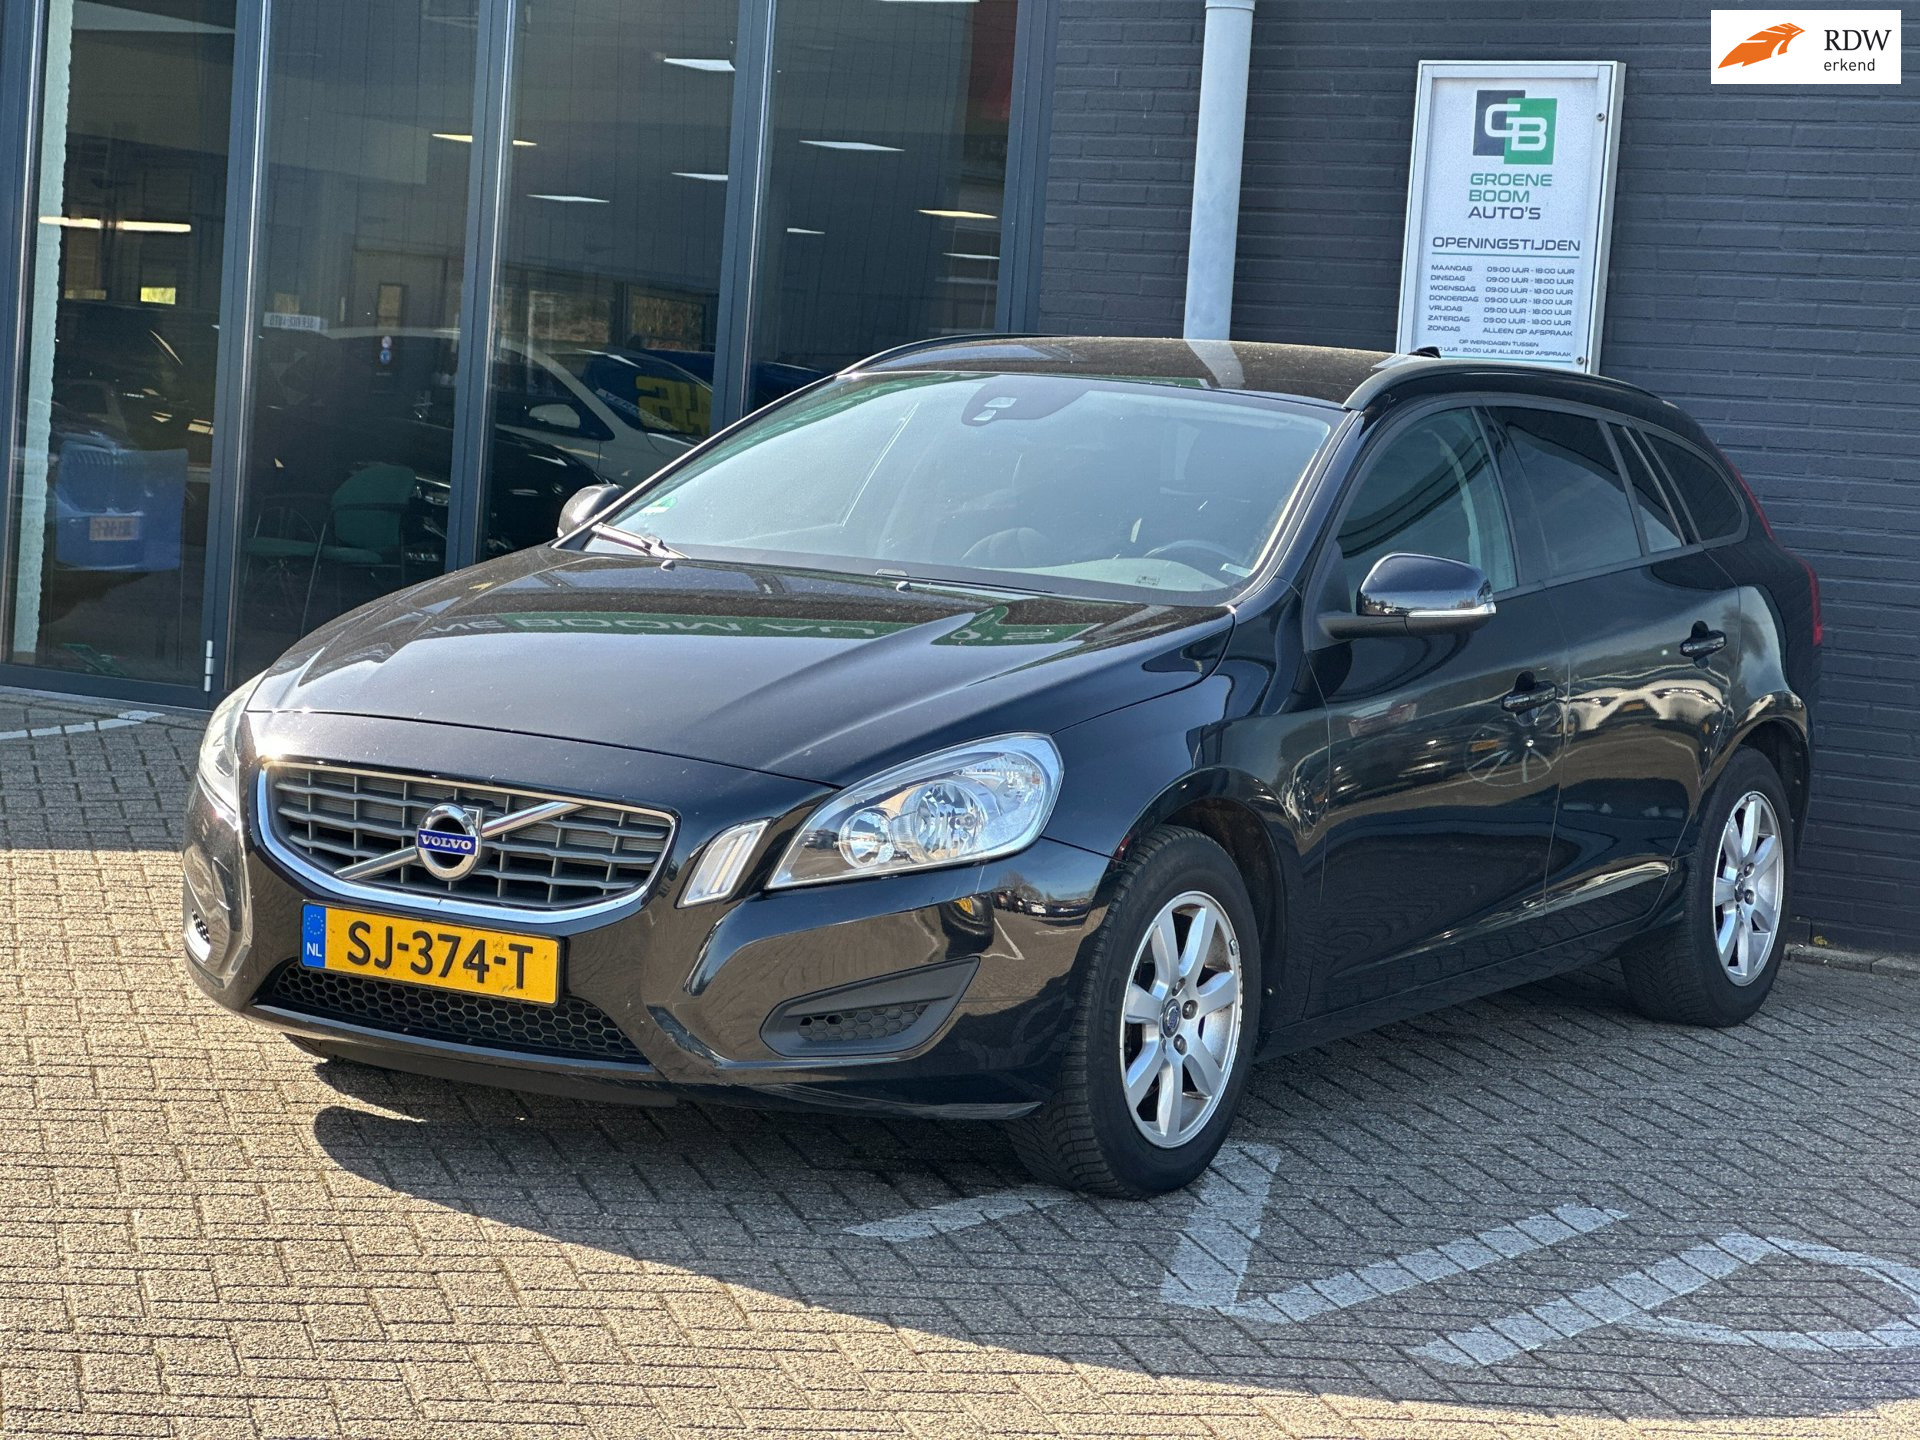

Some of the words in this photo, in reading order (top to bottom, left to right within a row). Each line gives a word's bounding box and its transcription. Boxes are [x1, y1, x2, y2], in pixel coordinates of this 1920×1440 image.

[1470, 172, 1552, 186] GROENE
[1468, 189, 1530, 203] BOOM
[1468, 206, 1541, 220] AUTO'S
[1432, 236, 1580, 252] OPENINGSTIJDEN
[1431, 264, 1472, 272] MAANDAG
[1428, 294, 1479, 302] DONDERDAG
[1427, 314, 1470, 322] ZATERDAG
[420, 833, 472, 850] VOLVO
[306, 942, 322, 958] NL
[346, 920, 534, 989] SJ-374-T
